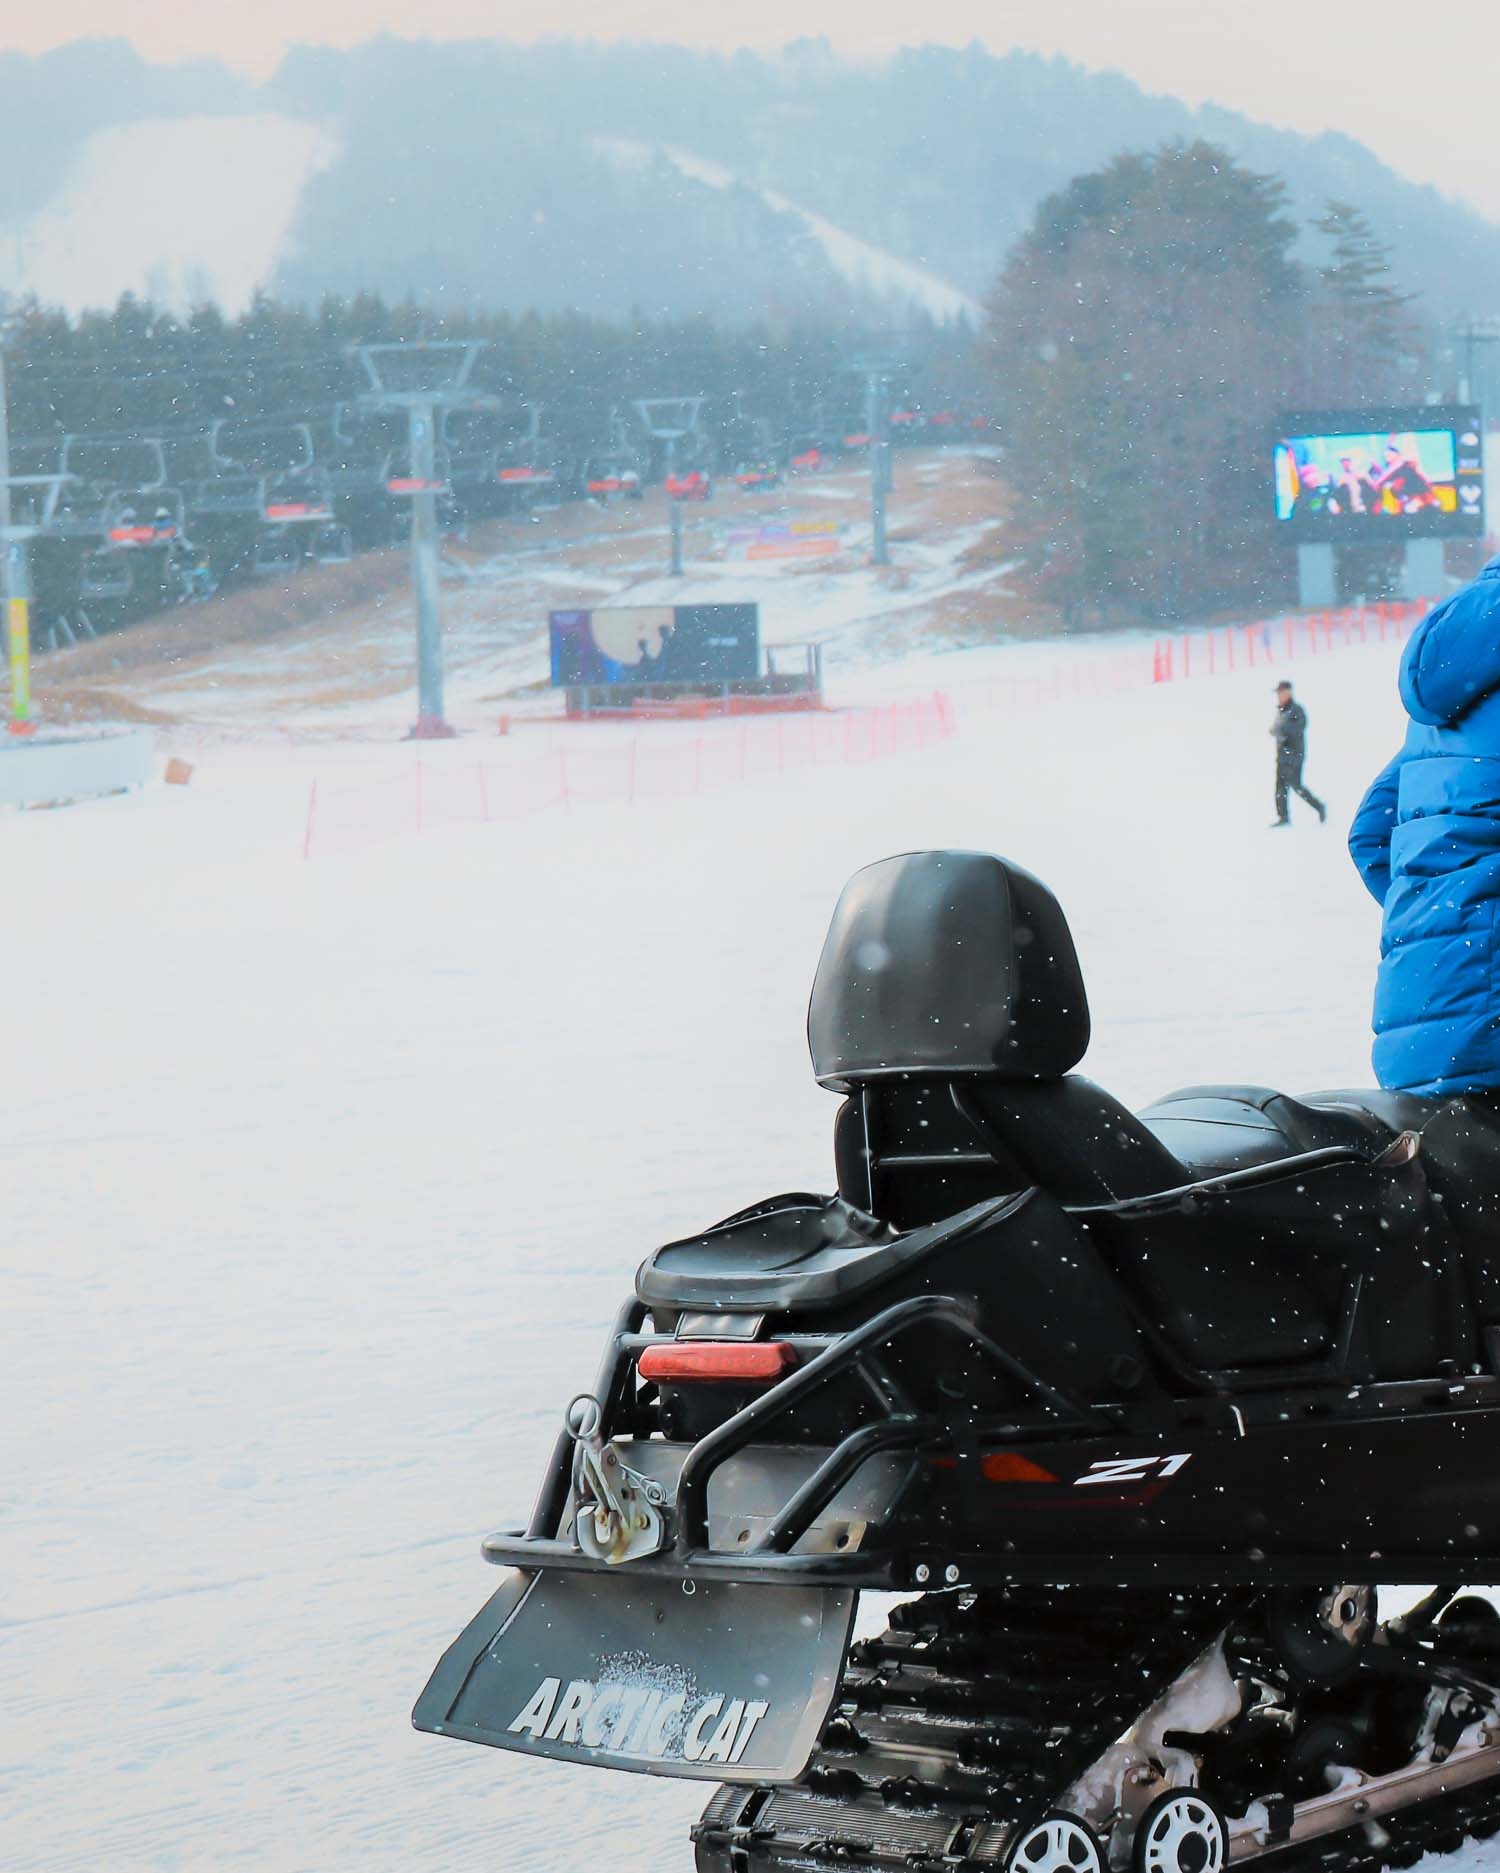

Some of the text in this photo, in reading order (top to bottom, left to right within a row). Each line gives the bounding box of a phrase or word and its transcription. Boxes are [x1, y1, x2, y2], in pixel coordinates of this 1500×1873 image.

[1073, 1453, 1192, 1485] Z1
[507, 1677, 769, 1763] ARCTIC CAT
